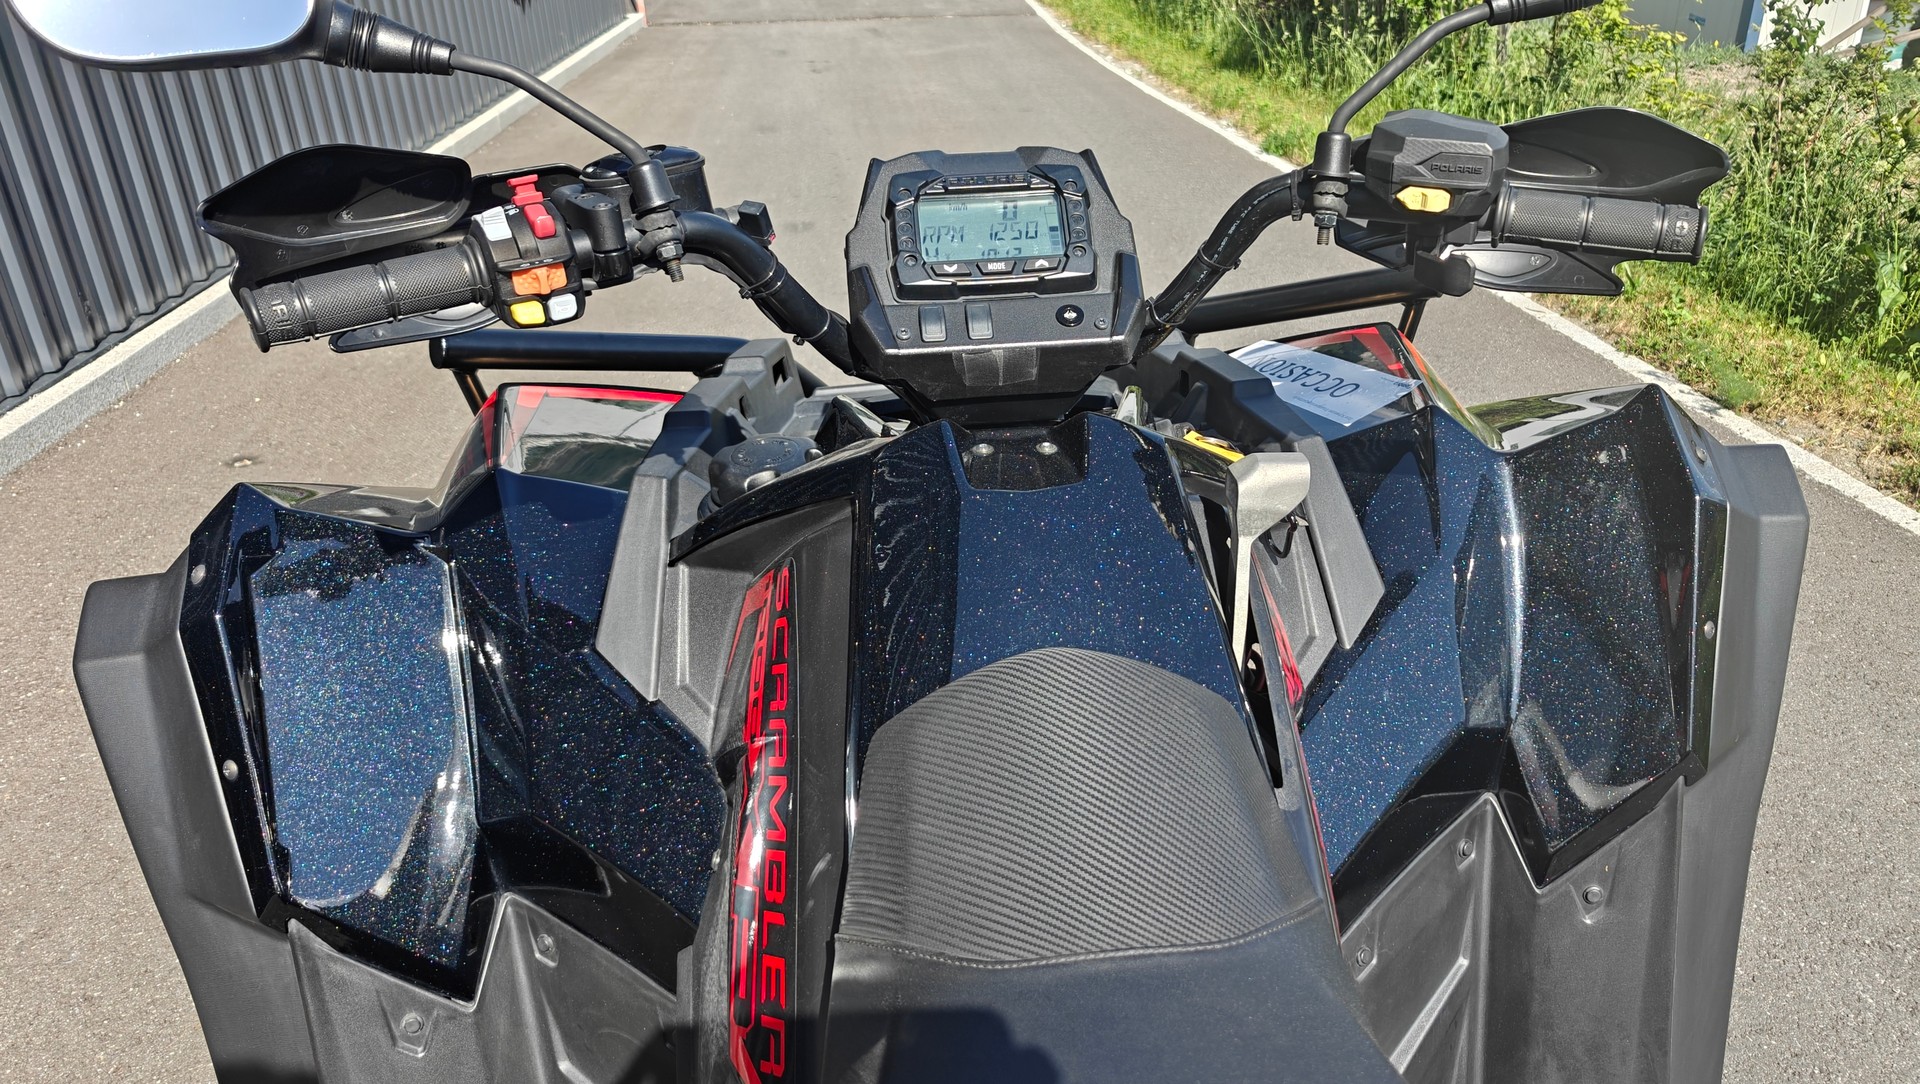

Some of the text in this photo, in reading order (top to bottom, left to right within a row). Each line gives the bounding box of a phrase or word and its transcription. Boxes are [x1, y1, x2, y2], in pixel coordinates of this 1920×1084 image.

[1429, 162, 1483, 175] POLARIS
[922, 224, 965, 244] RPM
[989, 221, 1039, 242] 1250
[1228, 220, 1240, 235] TUBE
[987, 261, 1006, 271] MODE
[1252, 354, 1360, 398] OCCASION
[759, 567, 791, 1078] SCRAMBLER
